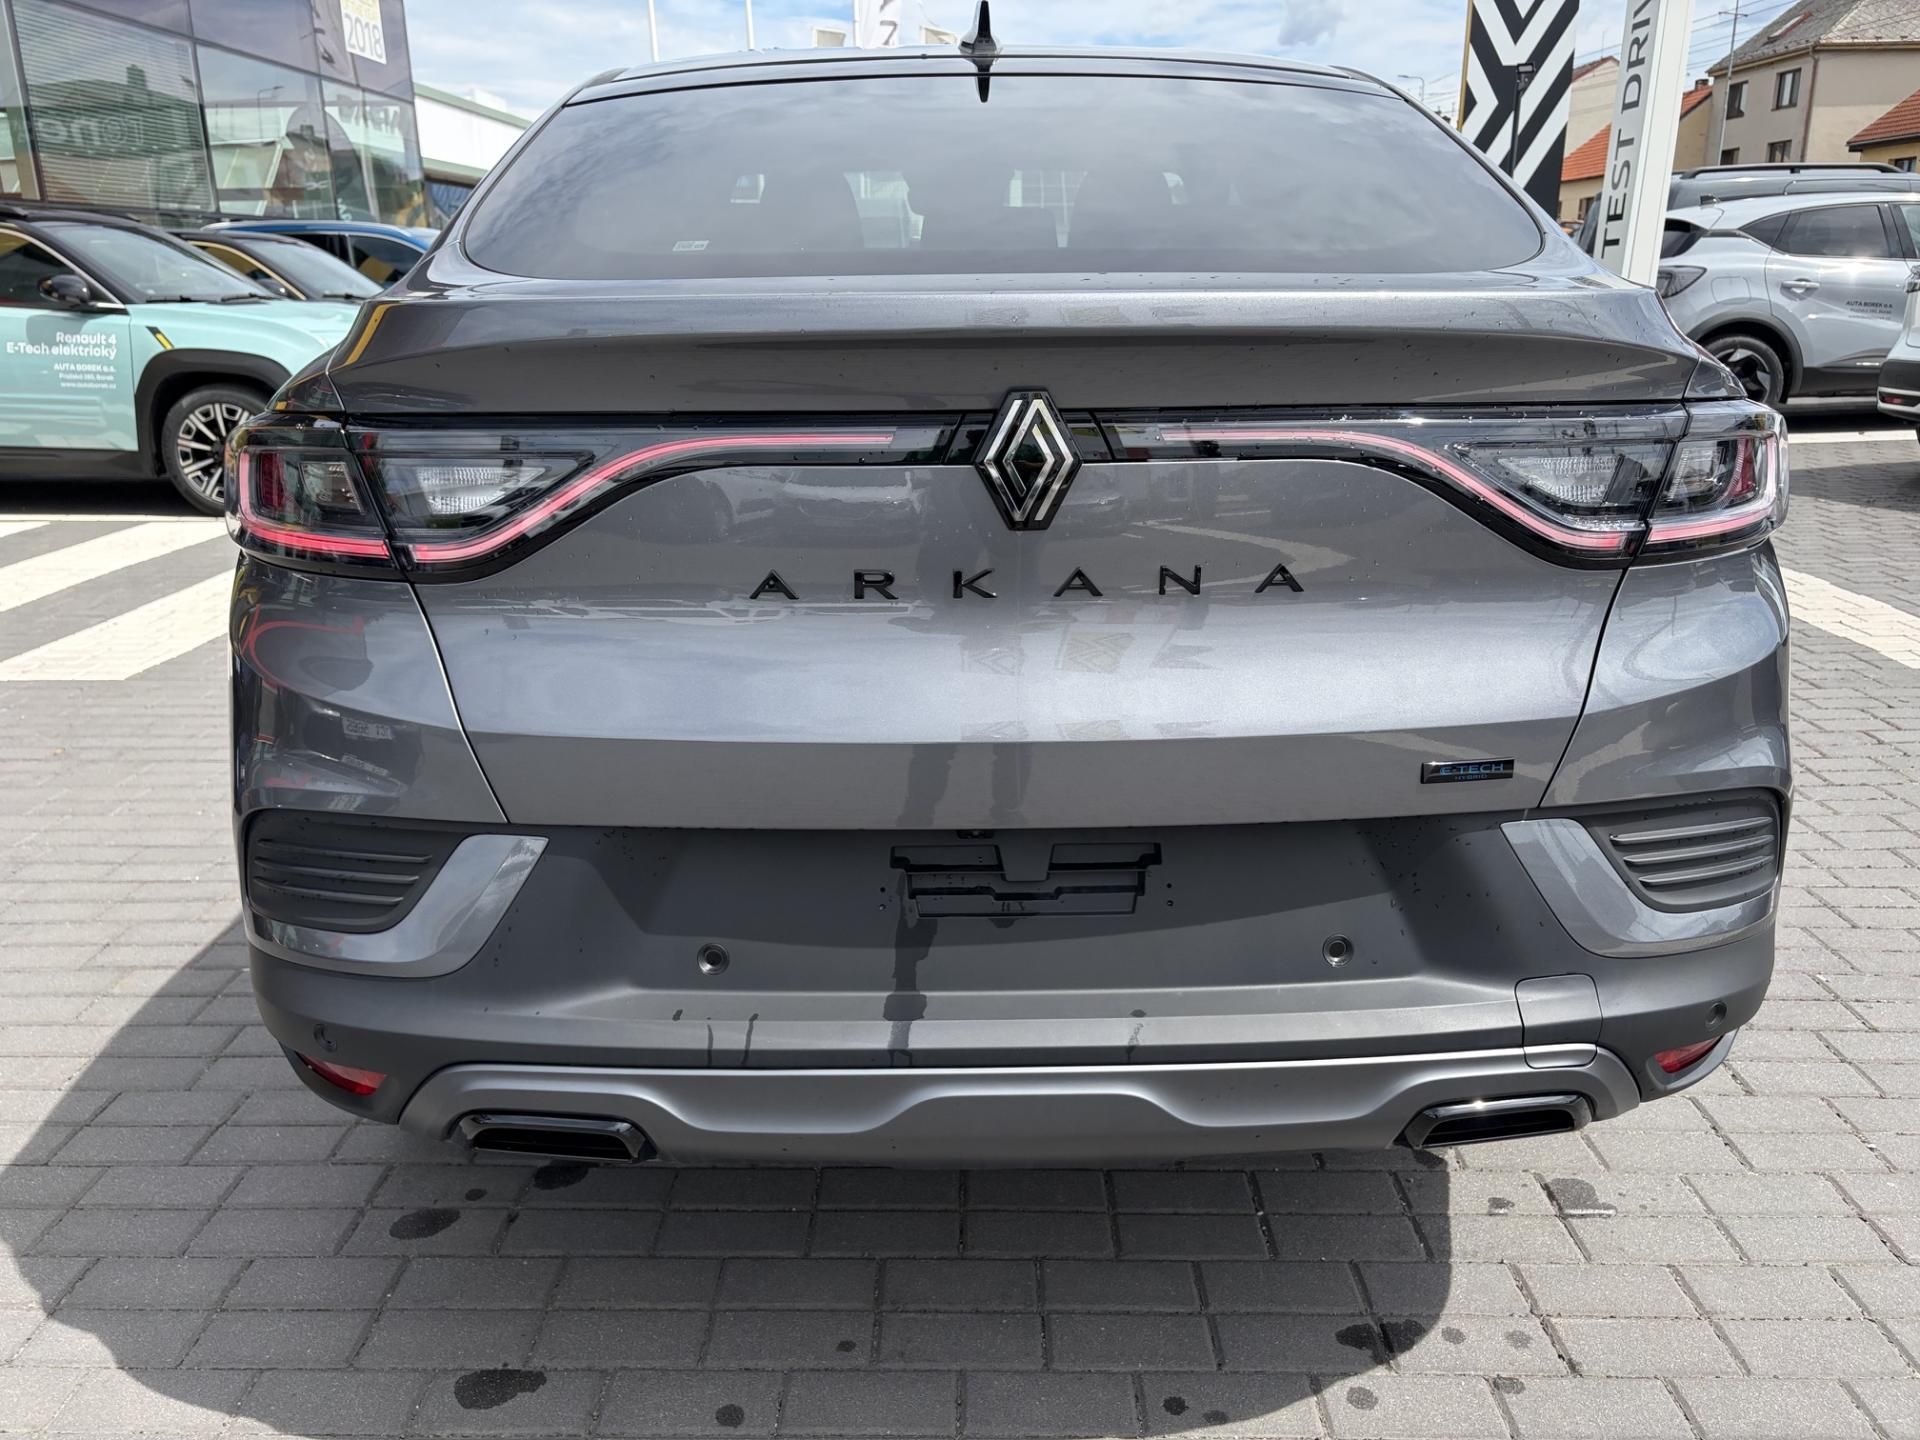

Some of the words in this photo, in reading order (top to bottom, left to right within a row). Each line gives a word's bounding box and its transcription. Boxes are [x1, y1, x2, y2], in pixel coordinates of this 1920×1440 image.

[344, 13, 384, 59] 2018
[1601, 128, 1635, 260] TEST
[56, 331, 106, 344] Renault
[108, 333, 117, 345] 4
[6, 341, 49, 354] E-Tech
[54, 362, 75, 371] AUTA
[749, 563, 1304, 600] ARKANA
[1440, 764, 1504, 775] E-TECH
